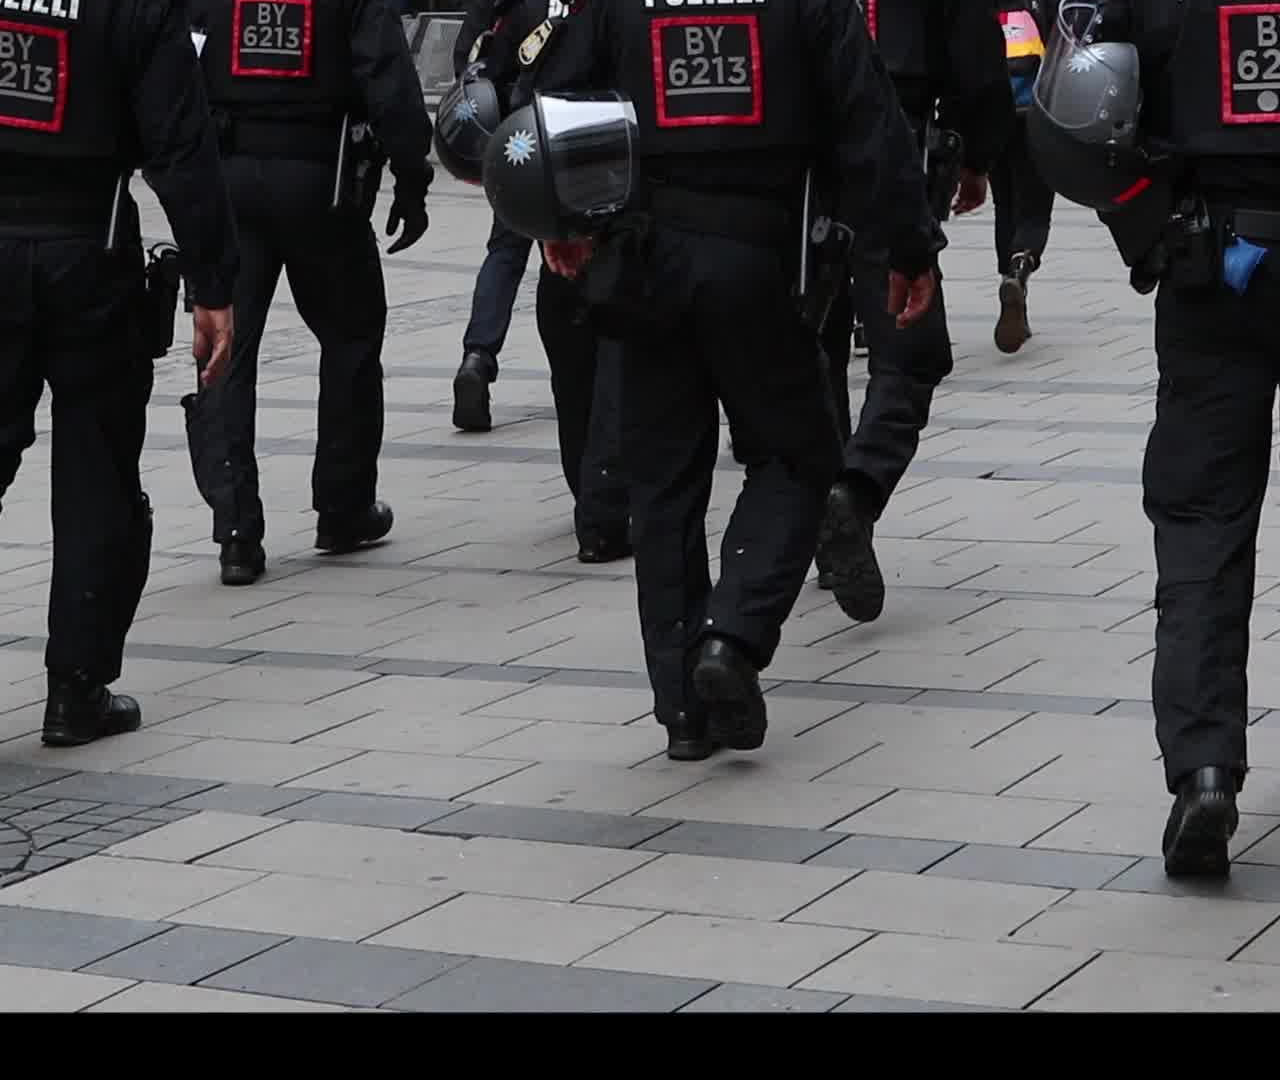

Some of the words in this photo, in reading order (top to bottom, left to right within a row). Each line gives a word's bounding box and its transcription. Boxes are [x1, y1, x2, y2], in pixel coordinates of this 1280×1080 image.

[257, 2, 287, 25] BY
[242, 25, 300, 49] 6213
[684, 25, 725, 56] BY
[668, 56, 747, 87] 6213
